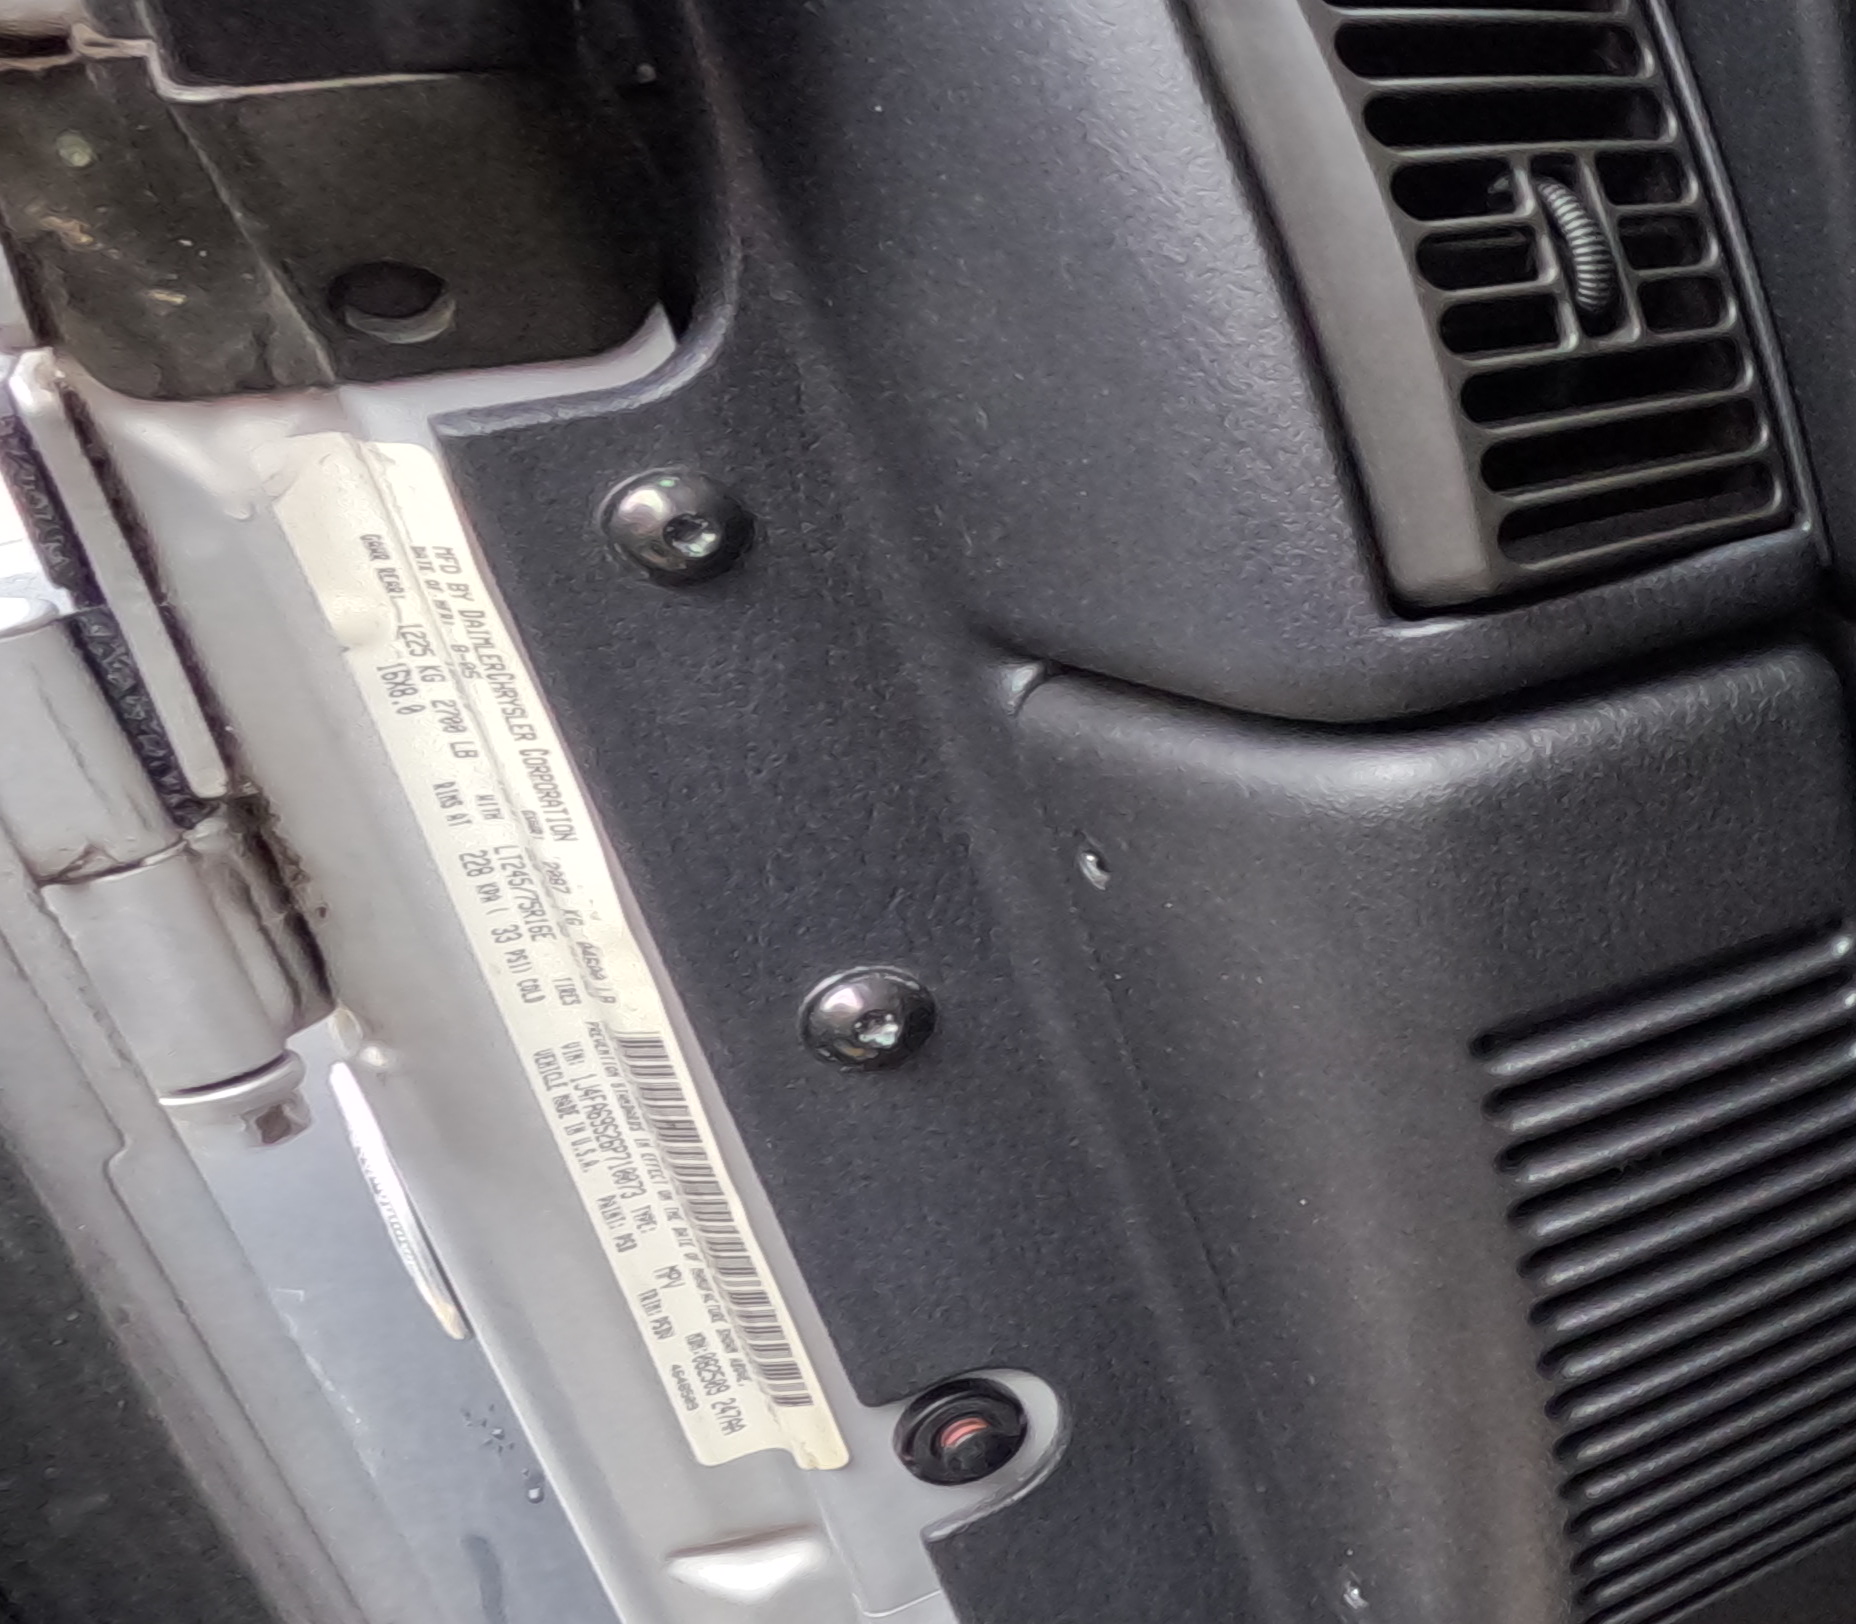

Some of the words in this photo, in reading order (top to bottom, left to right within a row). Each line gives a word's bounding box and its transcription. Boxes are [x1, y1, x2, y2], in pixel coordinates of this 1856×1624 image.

[431, 545, 463, 572] MFD
[446, 581, 474, 600] BY
[397, 625, 435, 655] 1225
[416, 663, 445, 683] KG
[430, 699, 467, 732] 2700
[448, 742, 479, 758] LB
[376, 662, 426, 715] 16X8.0
[458, 849, 494, 878] 228
[490, 924, 522, 944] 33
[652, 1264, 686, 1290] MPV
